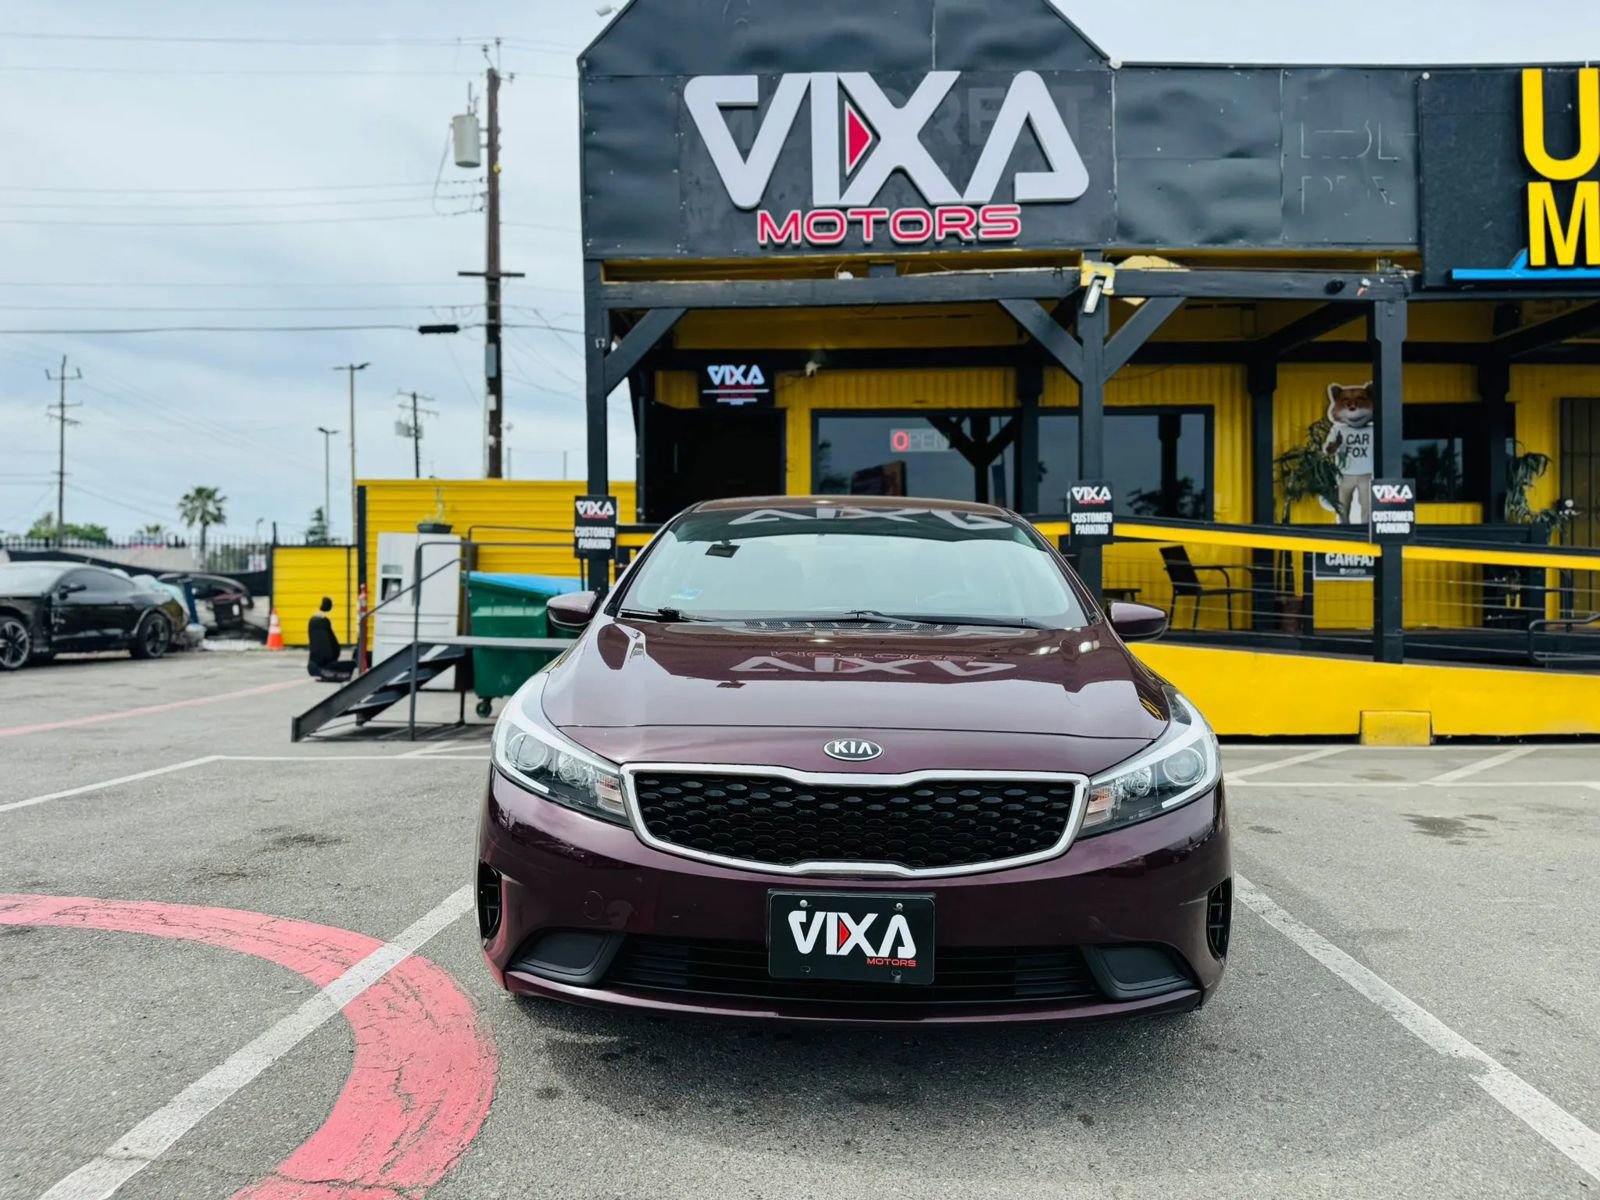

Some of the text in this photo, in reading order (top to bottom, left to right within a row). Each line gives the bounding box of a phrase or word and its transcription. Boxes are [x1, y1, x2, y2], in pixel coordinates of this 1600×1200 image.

[683, 70, 1091, 209] VIXA
[757, 204, 1023, 246] MOTORS
[707, 364, 766, 385] VIXA
[1346, 433, 1370, 446] CAR
[1345, 446, 1369, 458] FOX
[1071, 486, 1112, 501] VIXA
[1372, 485, 1413, 499] VIXA
[575, 500, 615, 515] VIXA
[1071, 512, 1113, 523] CUSTOMER
[1372, 510, 1414, 522] CUSTOMER
[574, 526, 616, 538] CUSTOMER
[1075, 523, 1109, 535] PARKING
[1376, 522, 1410, 534] PARKING
[834, 741, 873, 754] KIA
[788, 910, 917, 959] VIXA
[866, 957, 918, 967] MOTORS
